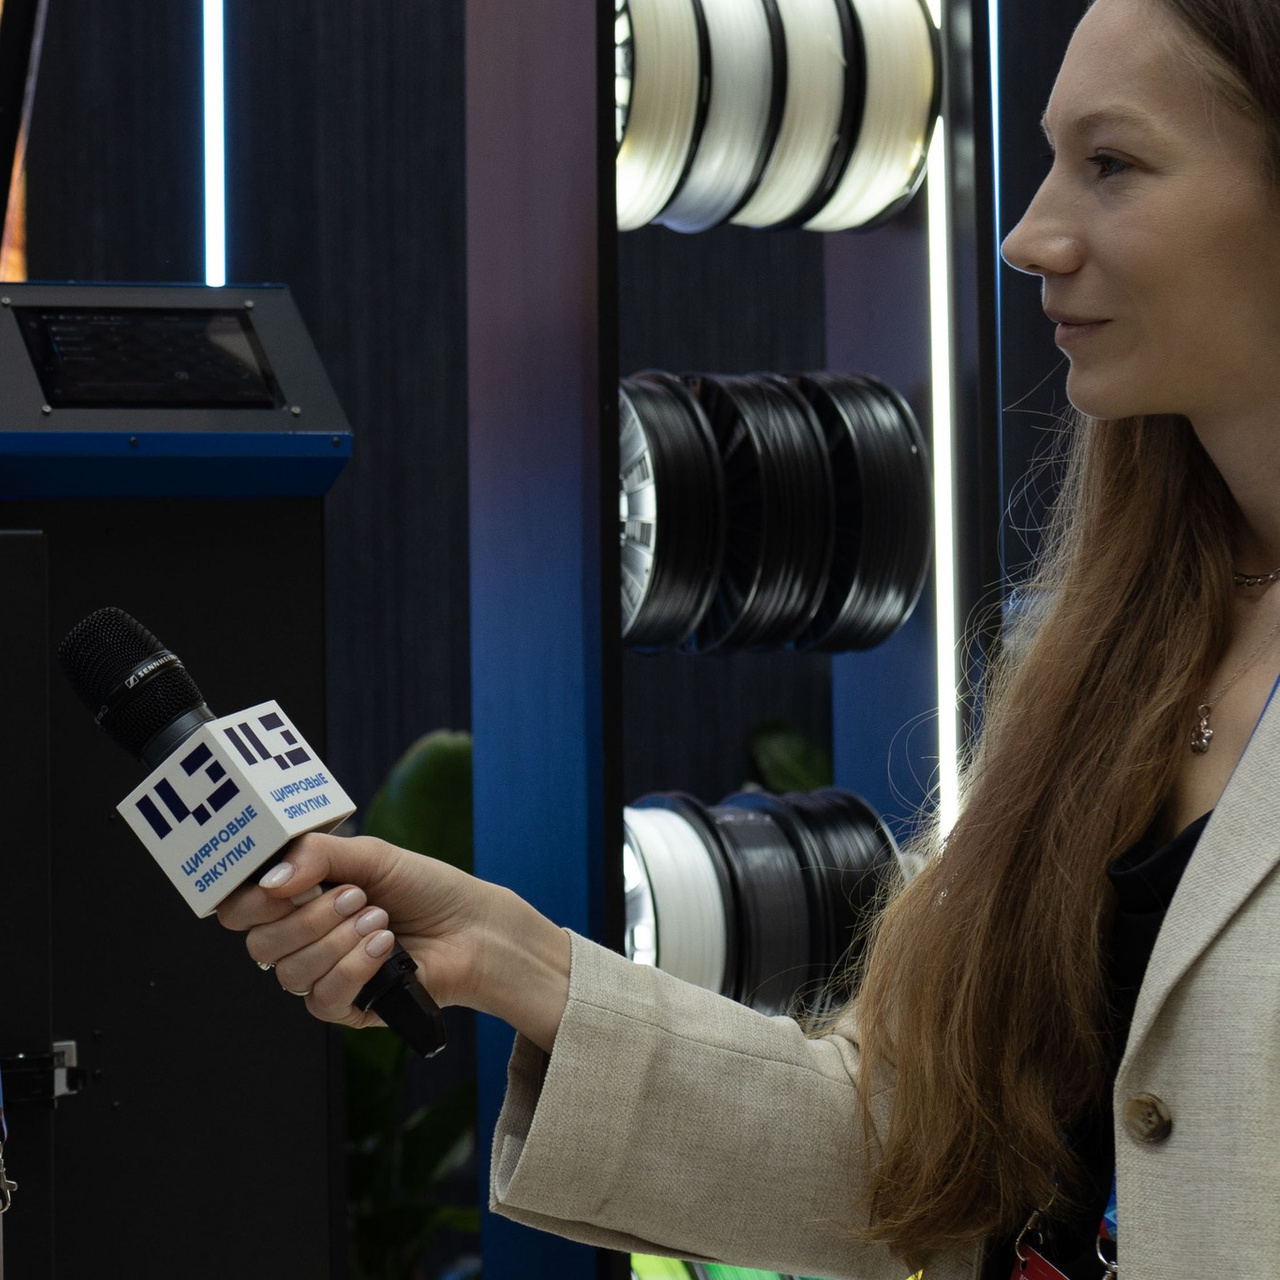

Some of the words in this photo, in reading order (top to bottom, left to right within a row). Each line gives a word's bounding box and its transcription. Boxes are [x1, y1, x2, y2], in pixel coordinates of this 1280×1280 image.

[270, 772, 329, 803] ЦИФРОВЫЕ
[284, 793, 331, 820] ЗАКУПКИ
[181, 804, 258, 877] ЦИФРОВЫЕ
[194, 835, 256, 893] ЗАКУПКИ
